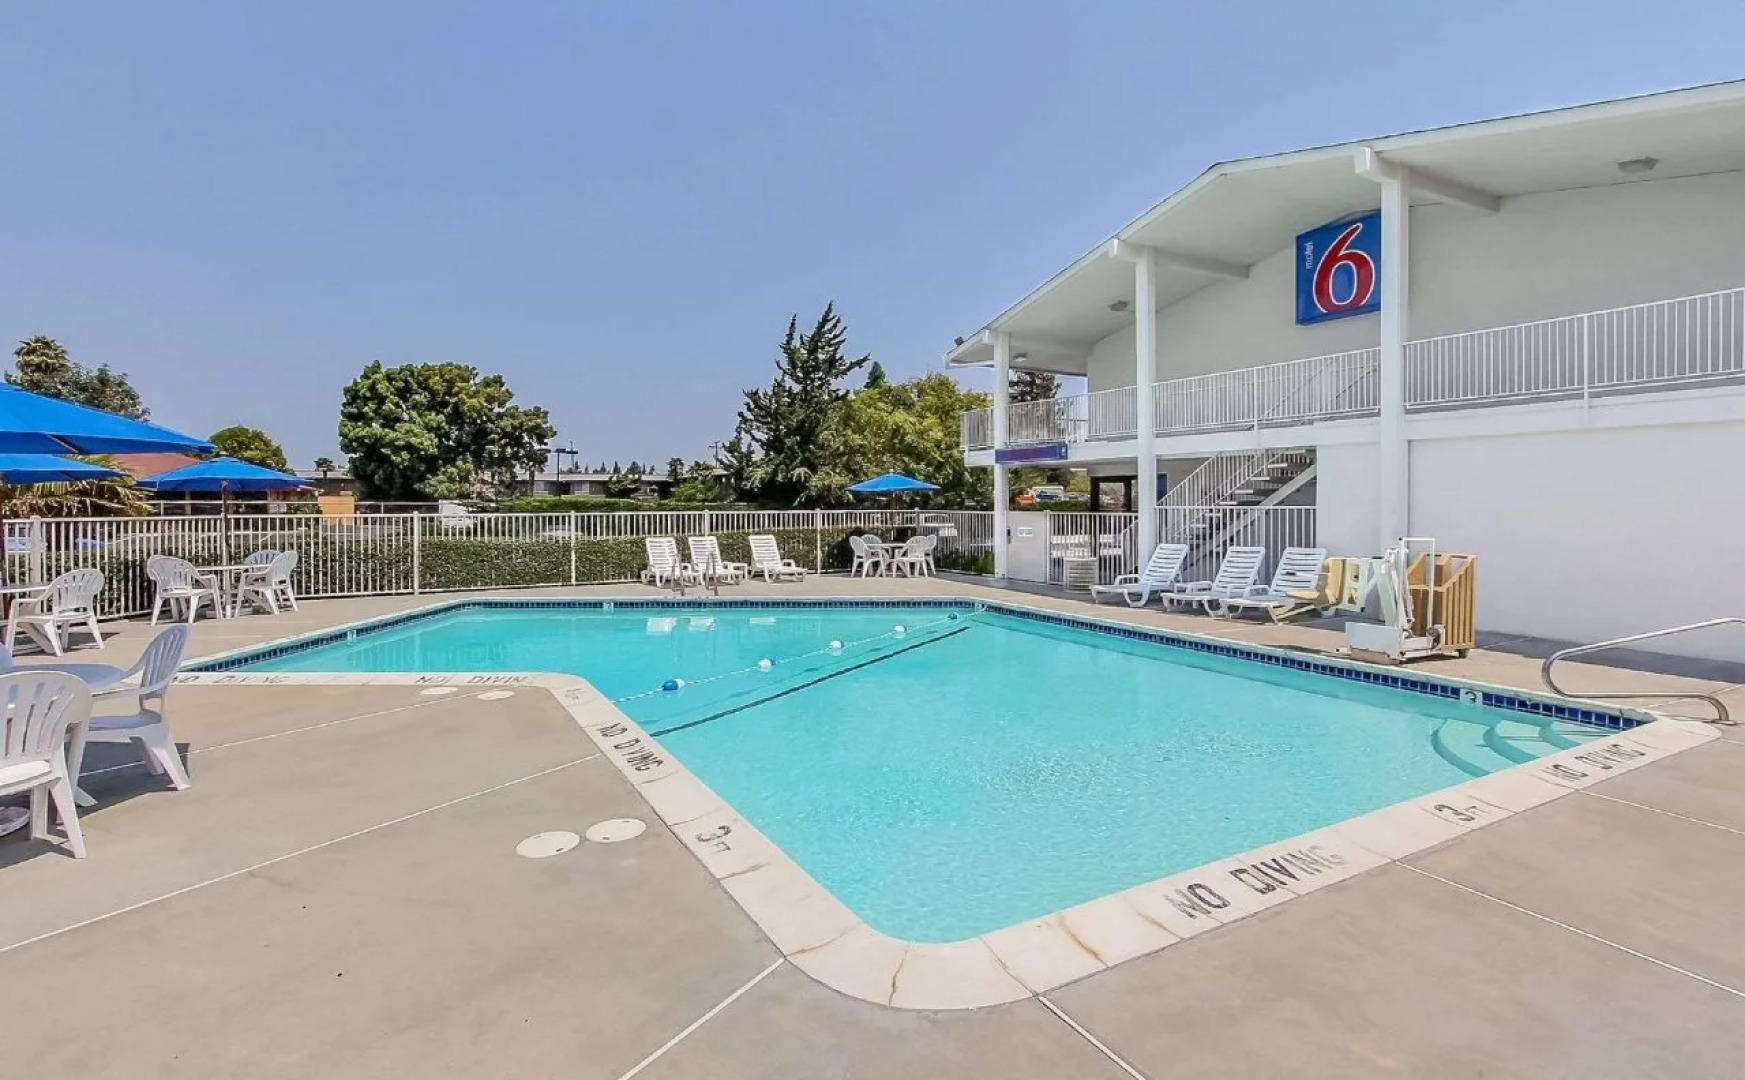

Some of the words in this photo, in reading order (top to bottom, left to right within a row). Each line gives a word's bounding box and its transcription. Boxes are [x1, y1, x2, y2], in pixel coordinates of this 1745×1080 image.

[1312, 222, 1376, 313] 6
[596, 722, 628, 738] NO
[1433, 803, 1476, 822] 3
[695, 825, 732, 842] 3
[1162, 883, 1232, 920] NO
[1228, 845, 1347, 895] DIVING
